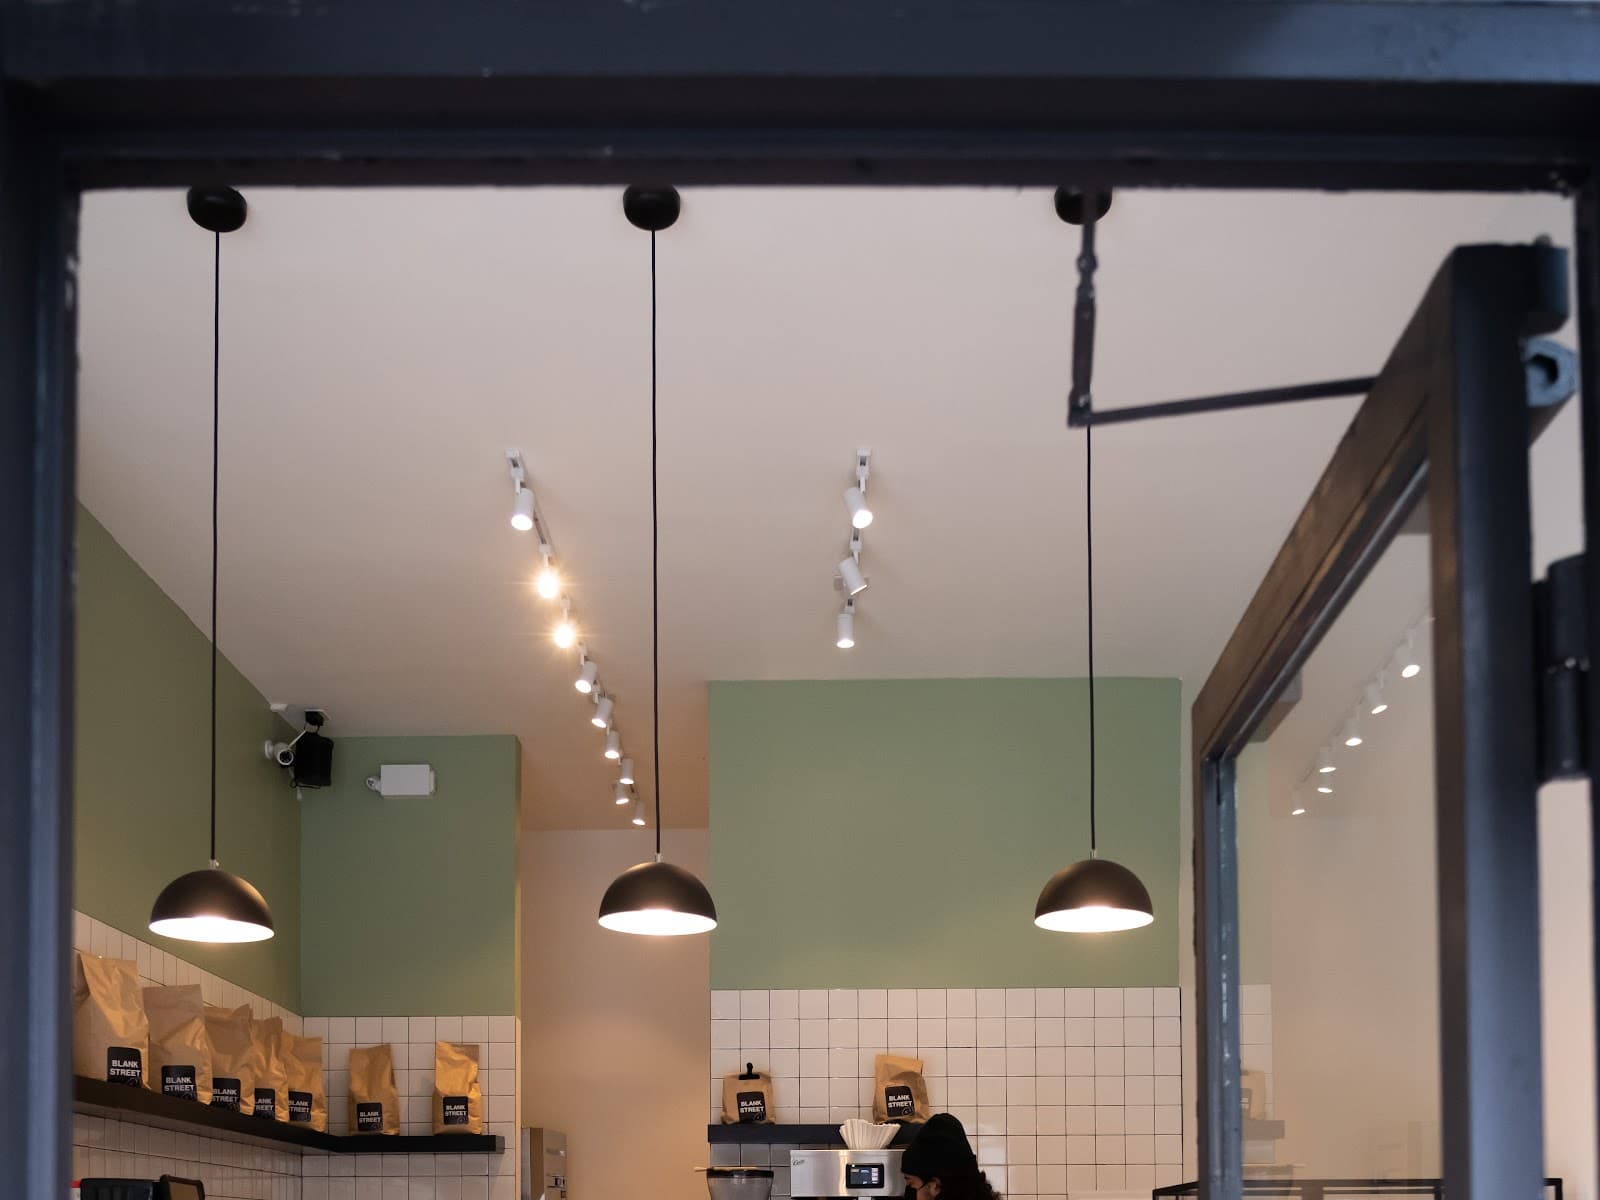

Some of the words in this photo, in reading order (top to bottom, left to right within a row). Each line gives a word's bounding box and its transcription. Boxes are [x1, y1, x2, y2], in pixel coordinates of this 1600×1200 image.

[112, 1060, 139, 1068] BLANK
[110, 1068, 141, 1077] STREET
[164, 1084, 195, 1092] STREET
[887, 1101, 913, 1109] STREET
